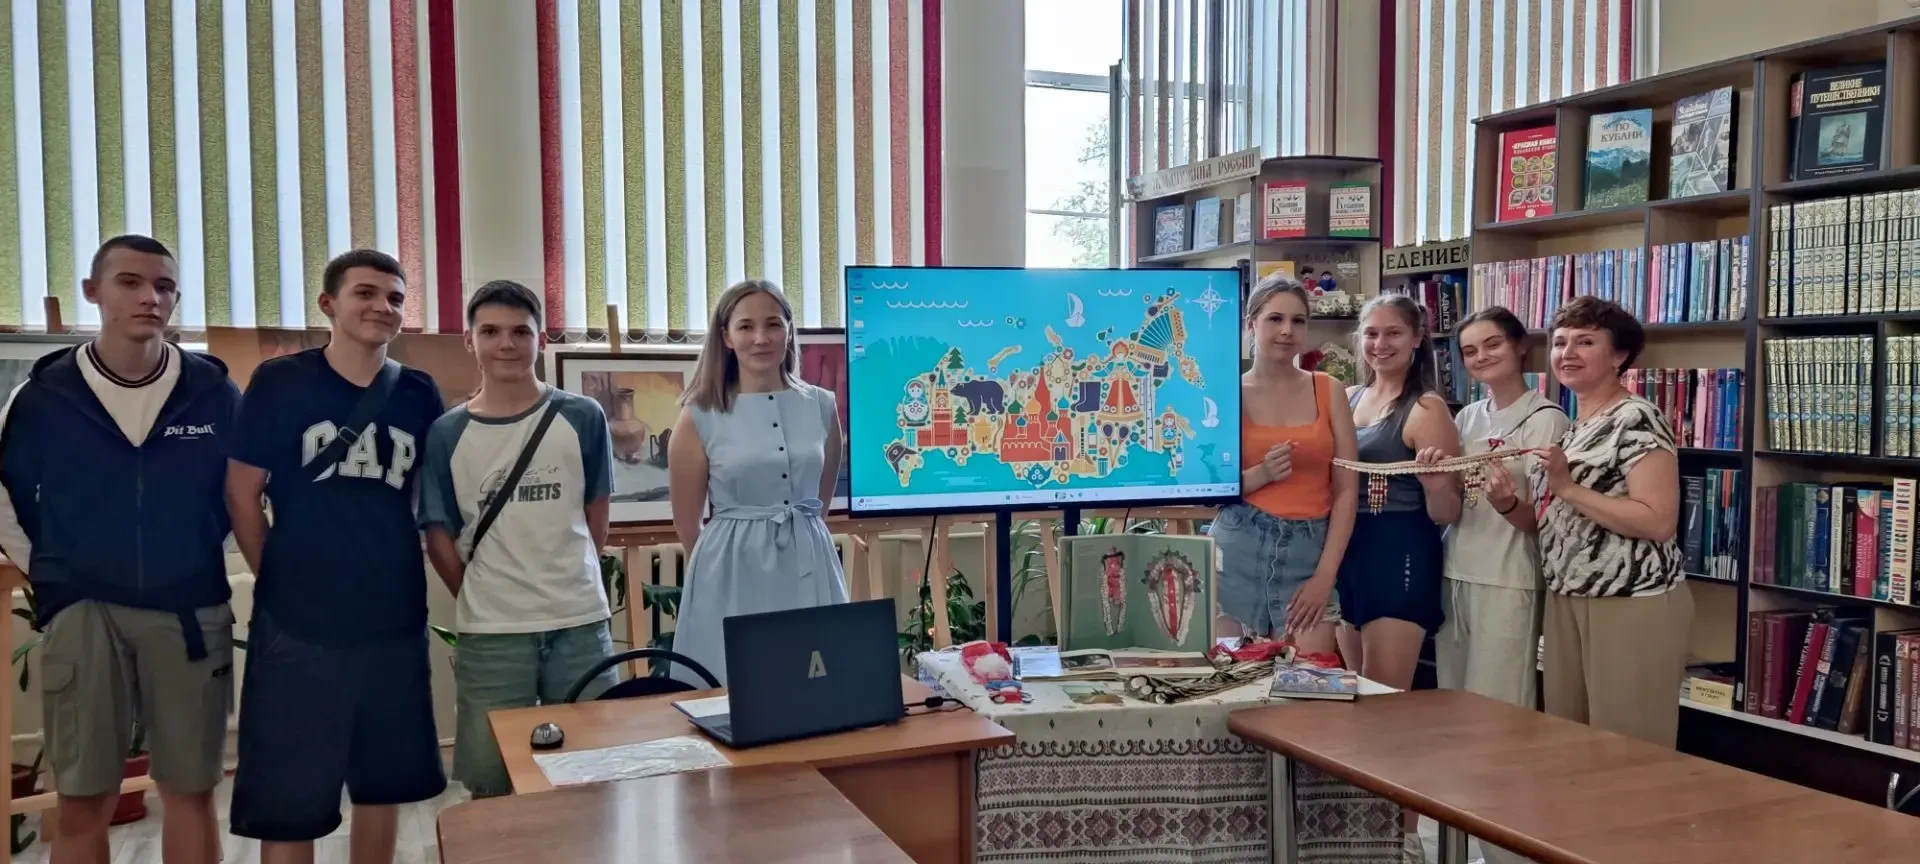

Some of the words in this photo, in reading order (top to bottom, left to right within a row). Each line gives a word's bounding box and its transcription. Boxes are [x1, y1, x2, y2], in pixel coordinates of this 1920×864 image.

[1829, 78, 1863, 91] ВЕЛИКИЕ
[1809, 85, 1881, 104] ПУТЕШЕСТВЕННИКИ
[1615, 122, 1630, 132] ПО
[1601, 131, 1643, 143] КУБАНИ
[1384, 246, 1461, 270] ЕДЕНИЕ
[163, 424, 185, 438] Pit
[186, 423, 216, 436] Bull
[517, 482, 562, 502] MEETS
